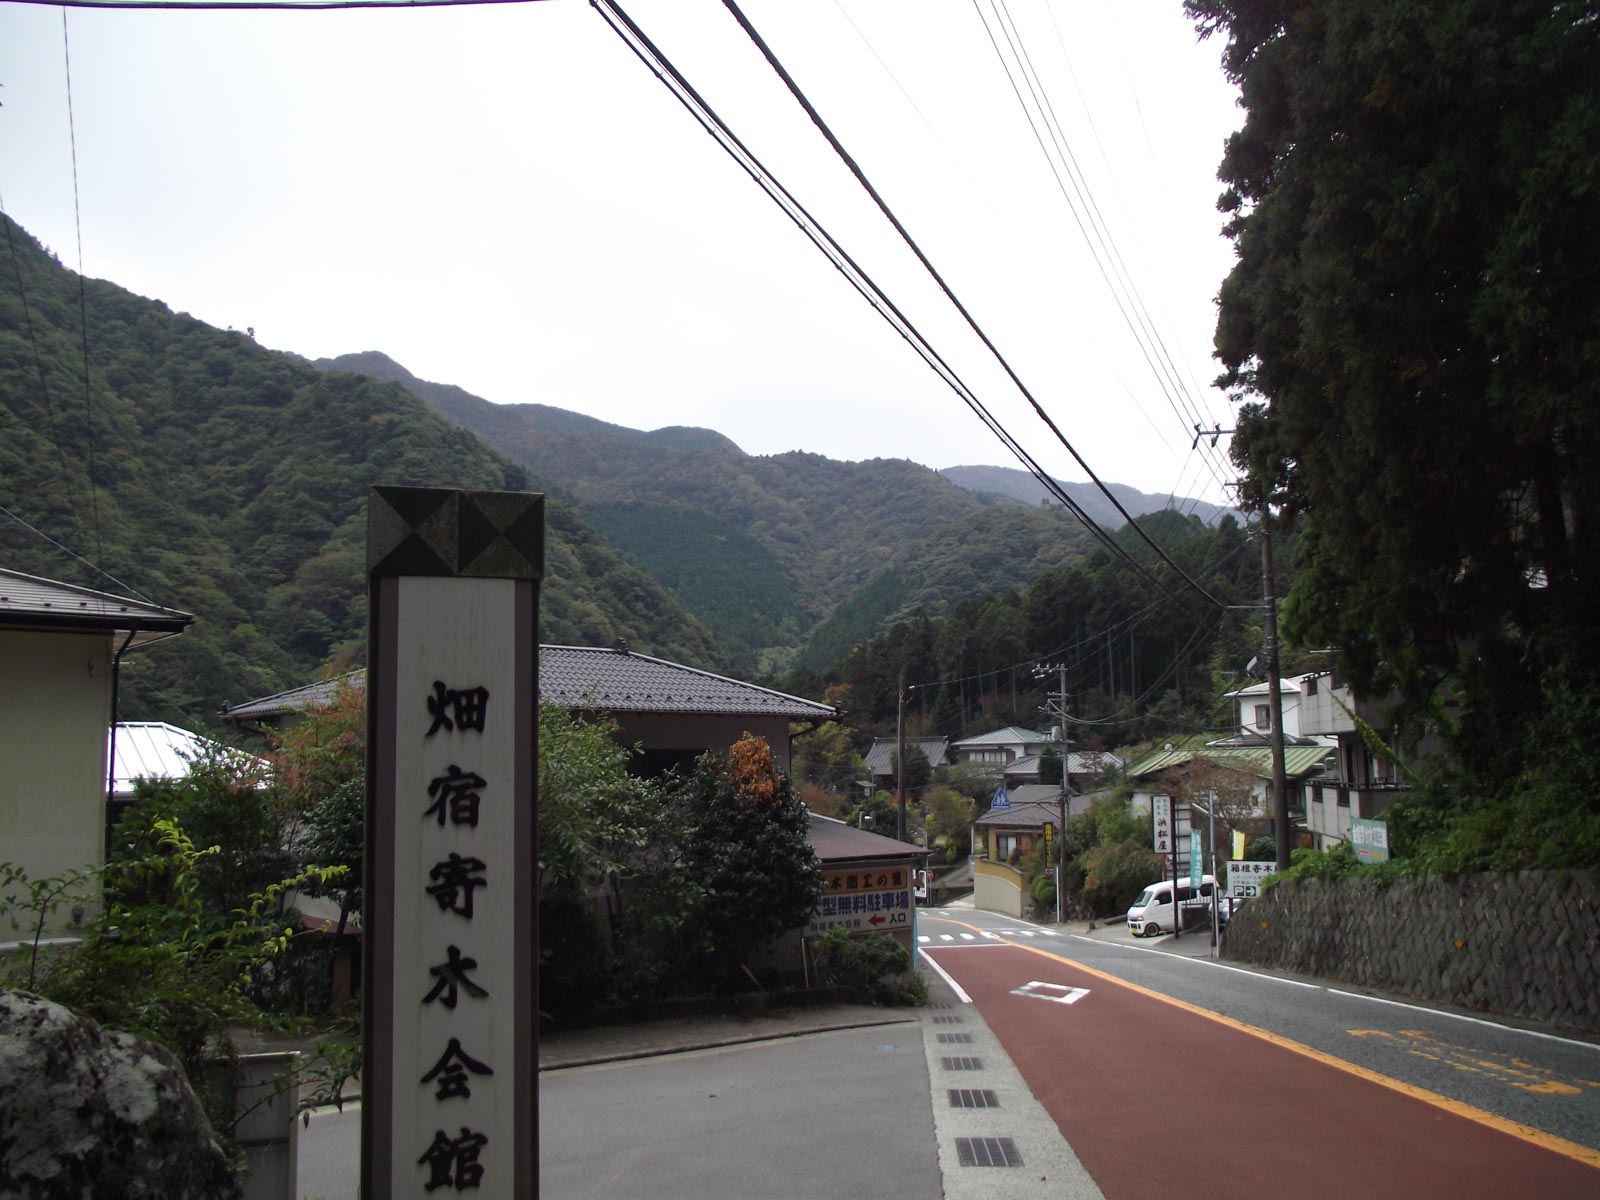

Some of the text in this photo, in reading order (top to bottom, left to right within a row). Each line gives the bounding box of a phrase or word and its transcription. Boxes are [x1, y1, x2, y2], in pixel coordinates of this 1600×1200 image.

[1156, 817, 1168, 850] 浜松屋
[889, 912, 907, 924] 入口
[418, 680, 494, 1192] 畑宿寄木会館
